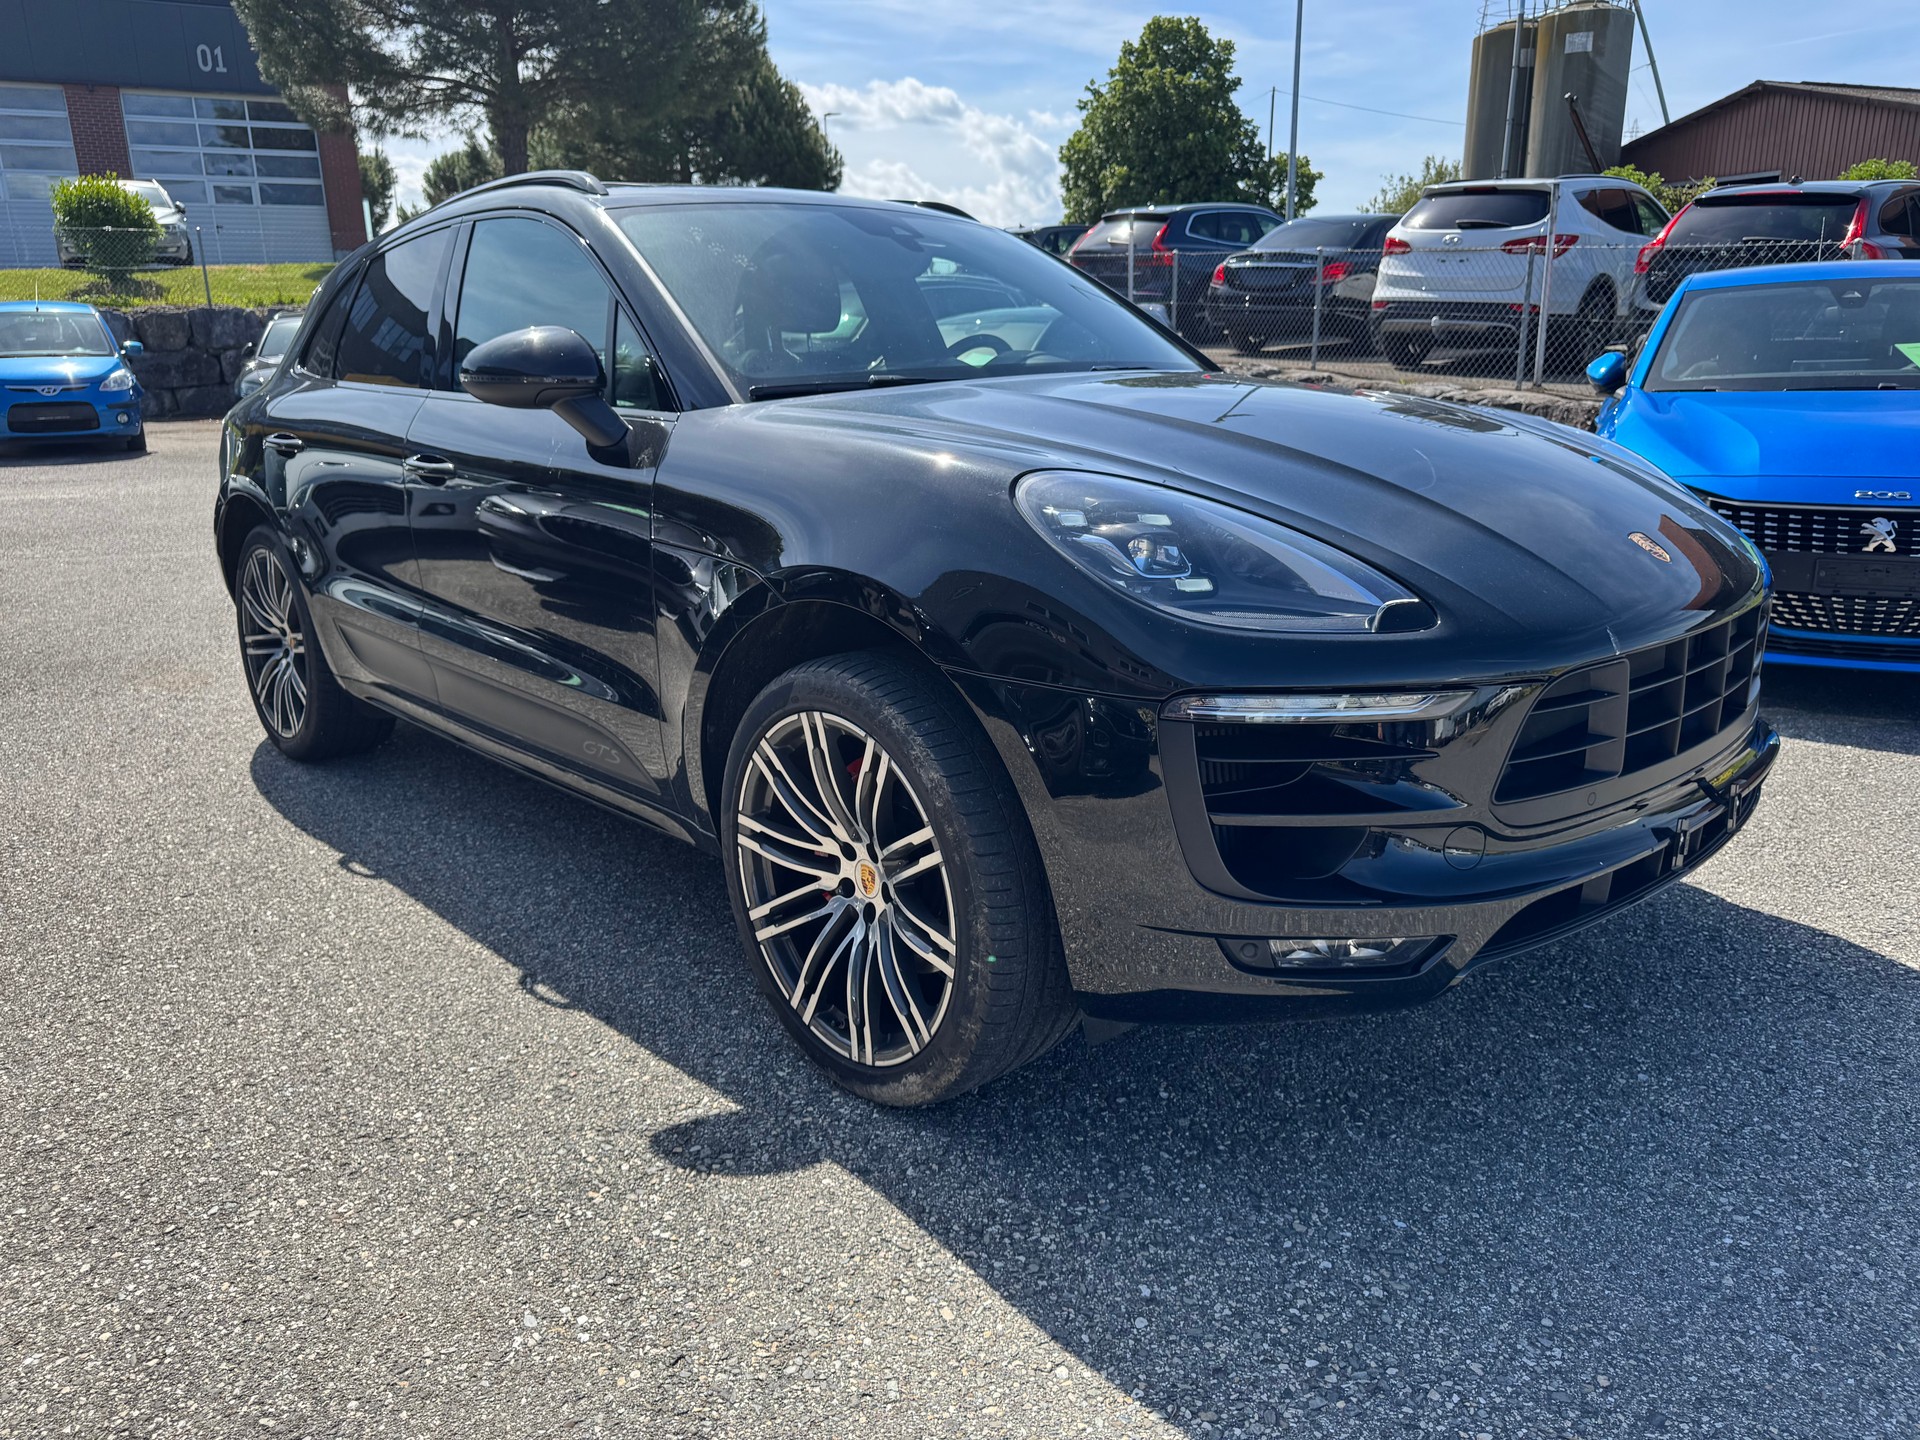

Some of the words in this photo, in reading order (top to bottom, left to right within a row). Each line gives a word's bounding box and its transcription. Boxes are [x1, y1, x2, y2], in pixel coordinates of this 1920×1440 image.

[196, 43, 227, 73] 01
[1854, 489, 1912, 500] 208
[583, 740, 621, 764] GTS
